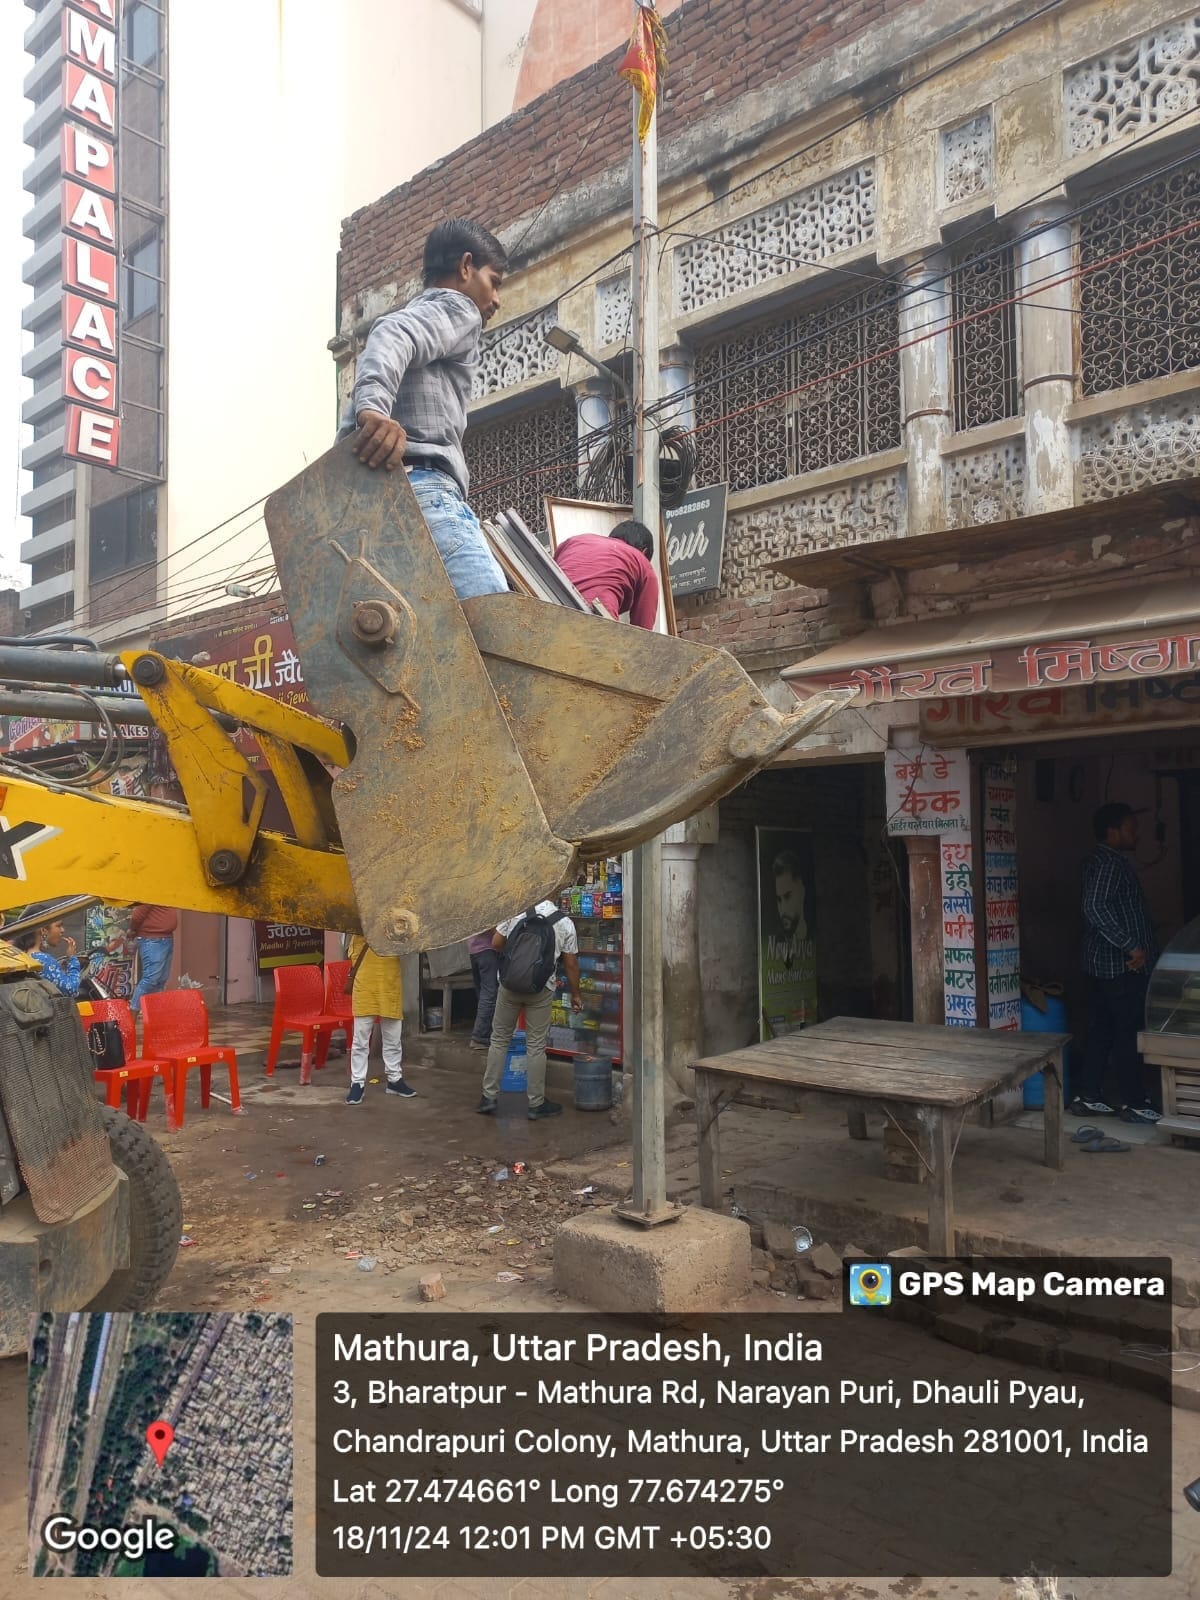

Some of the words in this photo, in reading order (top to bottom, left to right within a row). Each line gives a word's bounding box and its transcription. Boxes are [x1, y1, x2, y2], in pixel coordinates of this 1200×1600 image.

[930, 754, 957, 780] डे
[899, 785, 960, 817] केक
[944, 864, 973, 891] दही
[942, 890, 974, 914] लस्सी
[943, 915, 975, 939] पनीर
[944, 969, 976, 991] मटर
